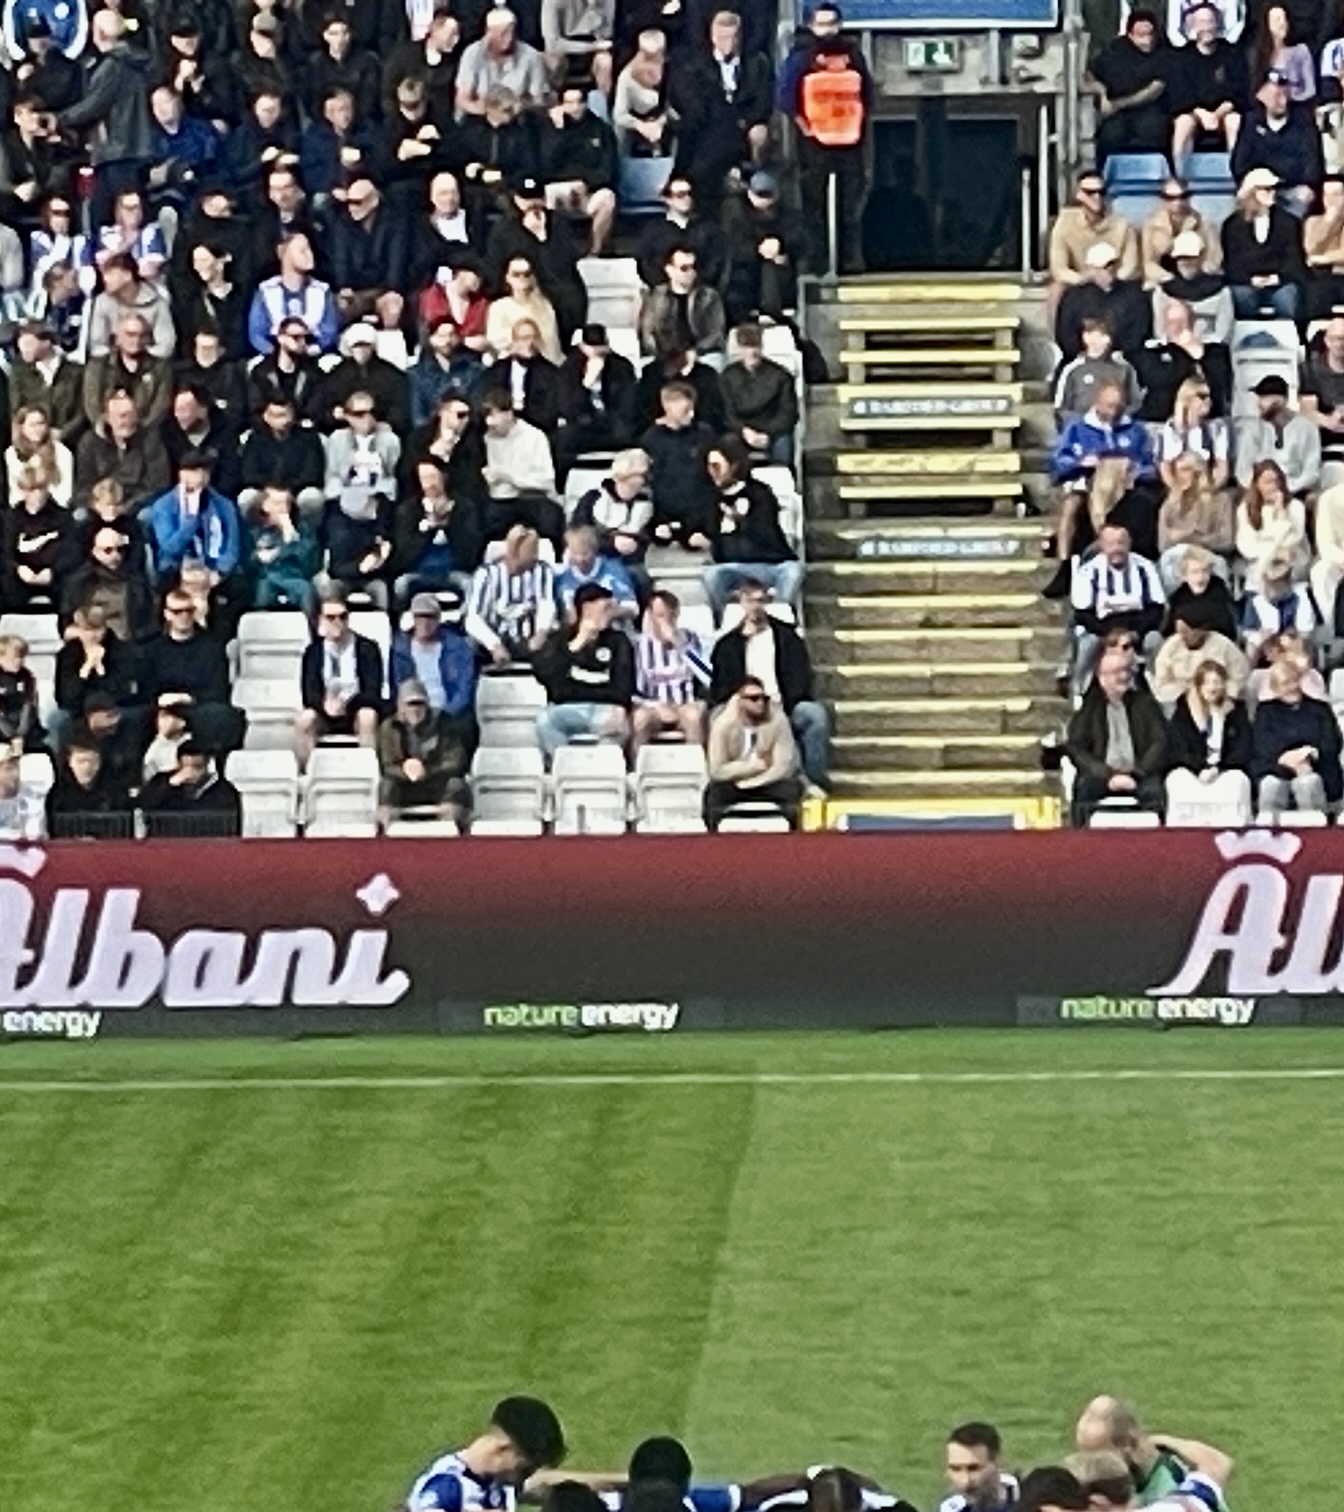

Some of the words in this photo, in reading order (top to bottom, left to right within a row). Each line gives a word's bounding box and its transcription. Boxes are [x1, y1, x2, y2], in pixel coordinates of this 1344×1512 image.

[484, 1003, 577, 1026] nature
[582, 1003, 678, 1030] energy
[1061, 996, 1153, 1018] nature
[1157, 998, 1255, 1024] energy
[3, 1011, 101, 1037] energy
